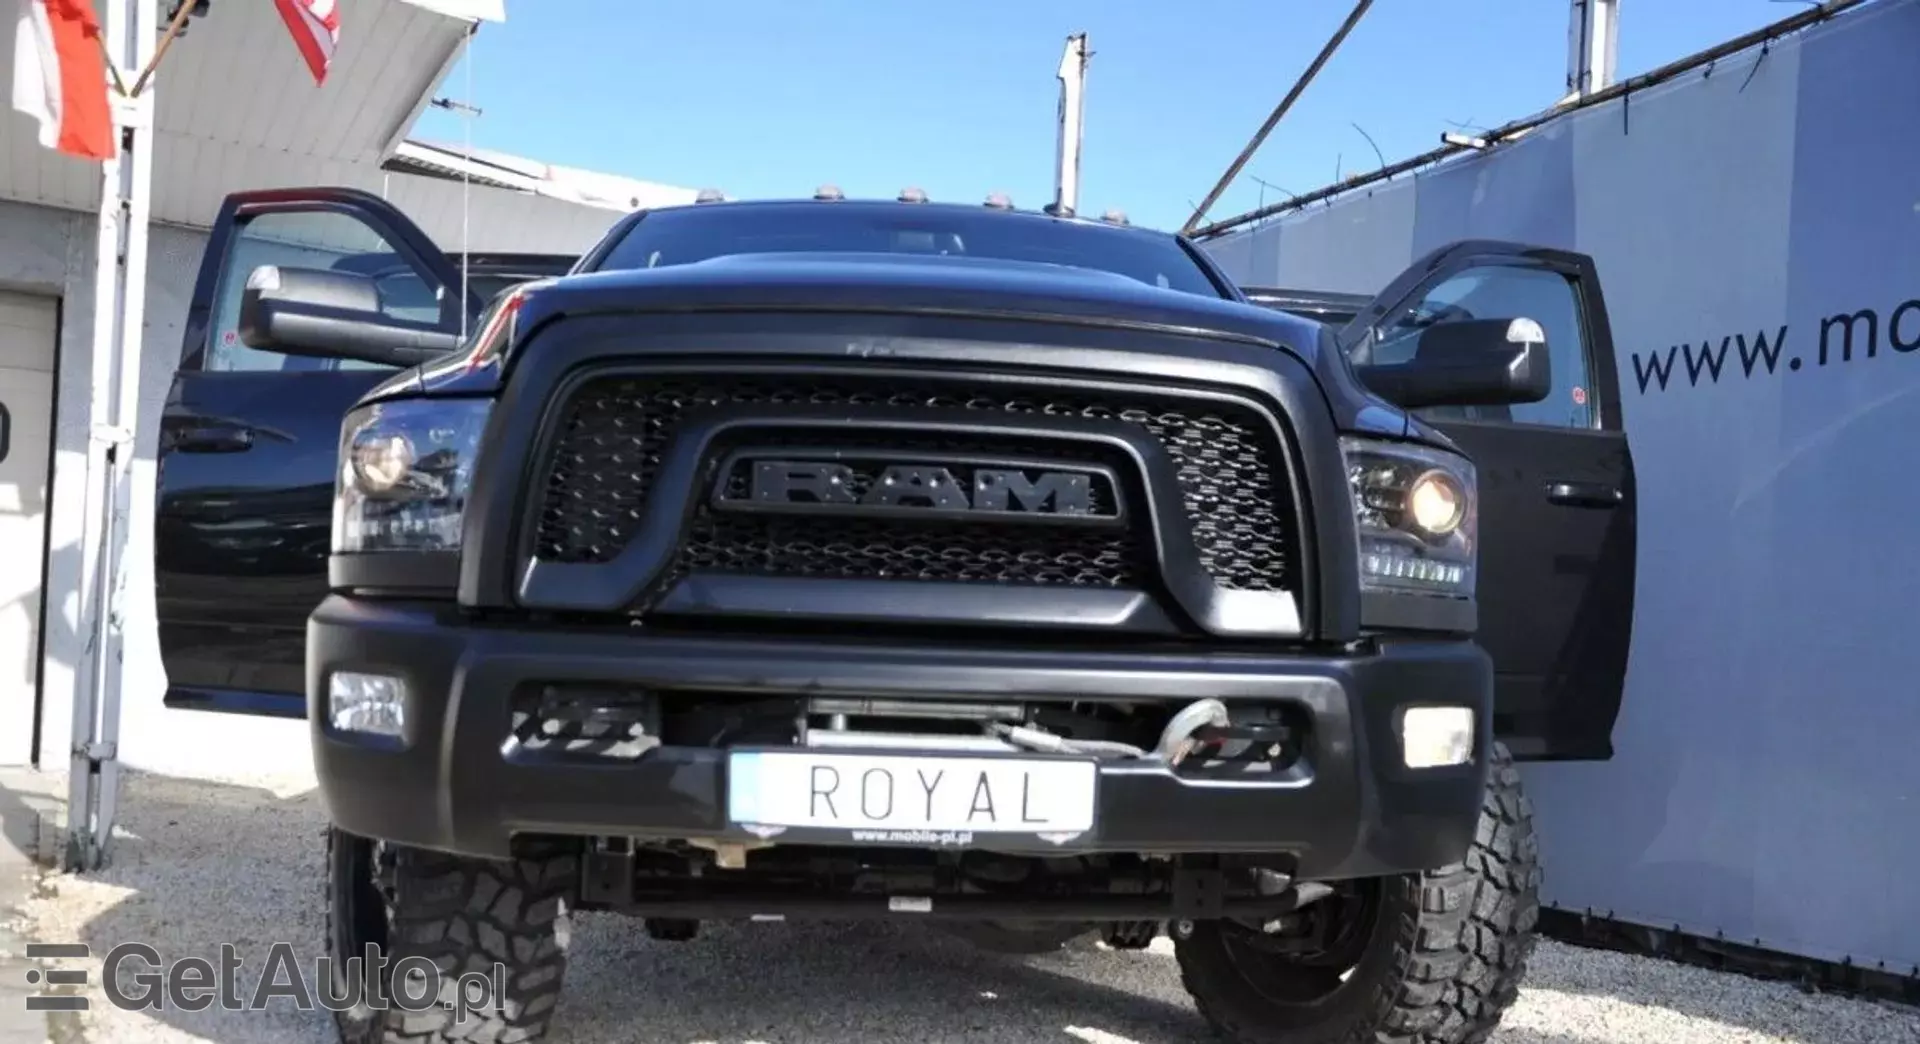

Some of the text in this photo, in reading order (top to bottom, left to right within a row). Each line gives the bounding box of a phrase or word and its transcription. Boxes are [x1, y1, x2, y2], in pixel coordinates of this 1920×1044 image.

[751, 461, 1091, 515] RAM
[810, 765, 1049, 824] ROYAL
[851, 829, 973, 845] www.mobile-pl.pl
